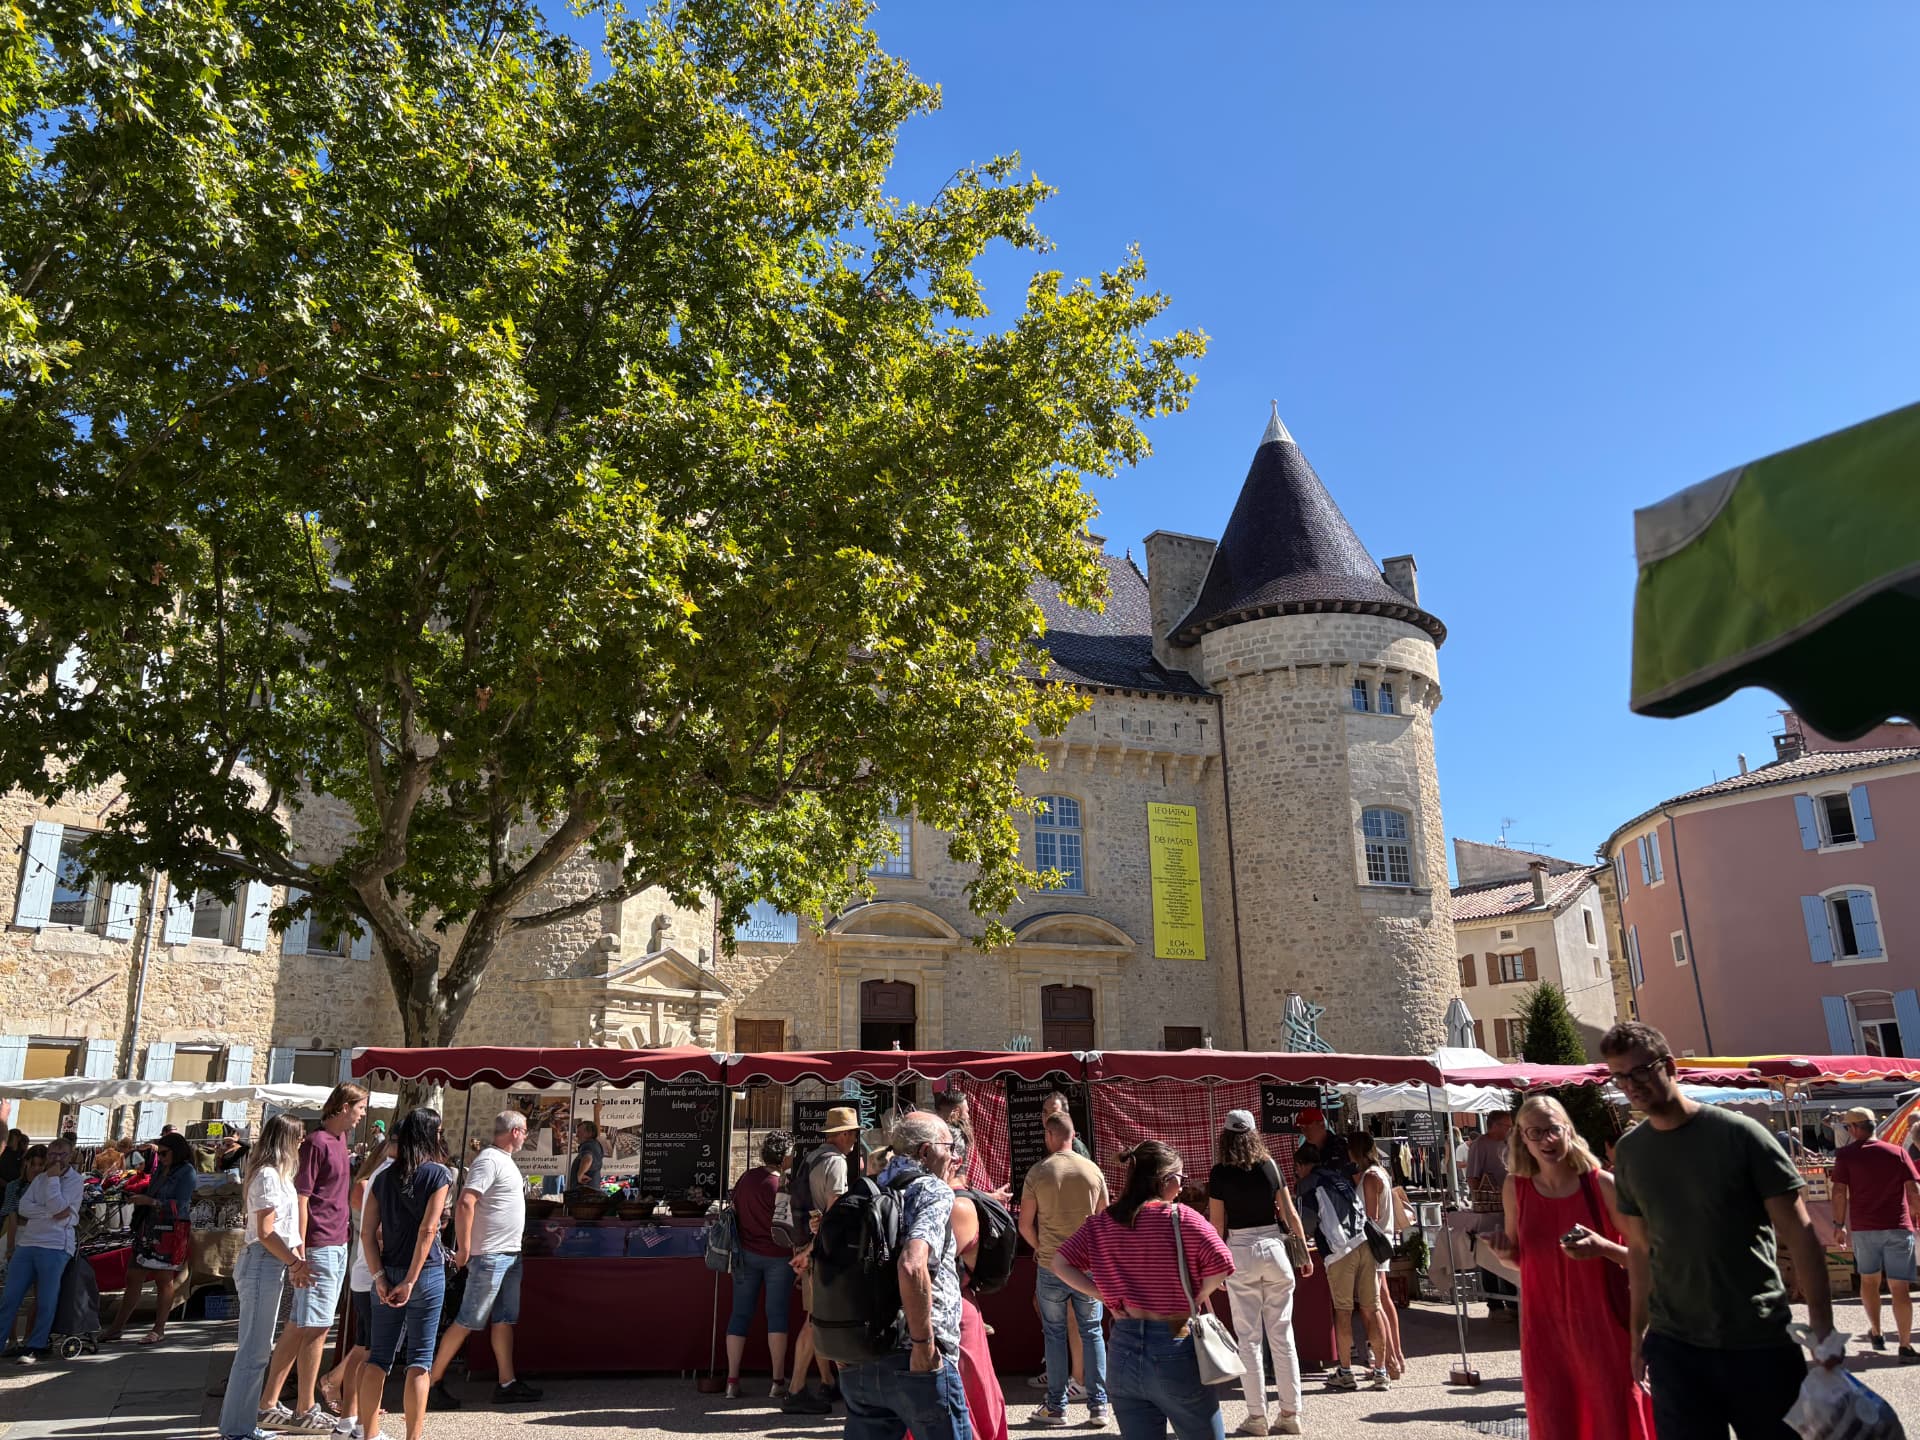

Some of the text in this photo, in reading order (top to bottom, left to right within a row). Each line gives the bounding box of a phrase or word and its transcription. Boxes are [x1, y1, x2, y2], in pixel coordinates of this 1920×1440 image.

[1266, 1092, 1317, 1108] 3 SAUCISSONS
[1272, 1115, 1289, 1124] POUR
[702, 1144, 711, 1157] 3
[694, 1172, 717, 1185] 10€
